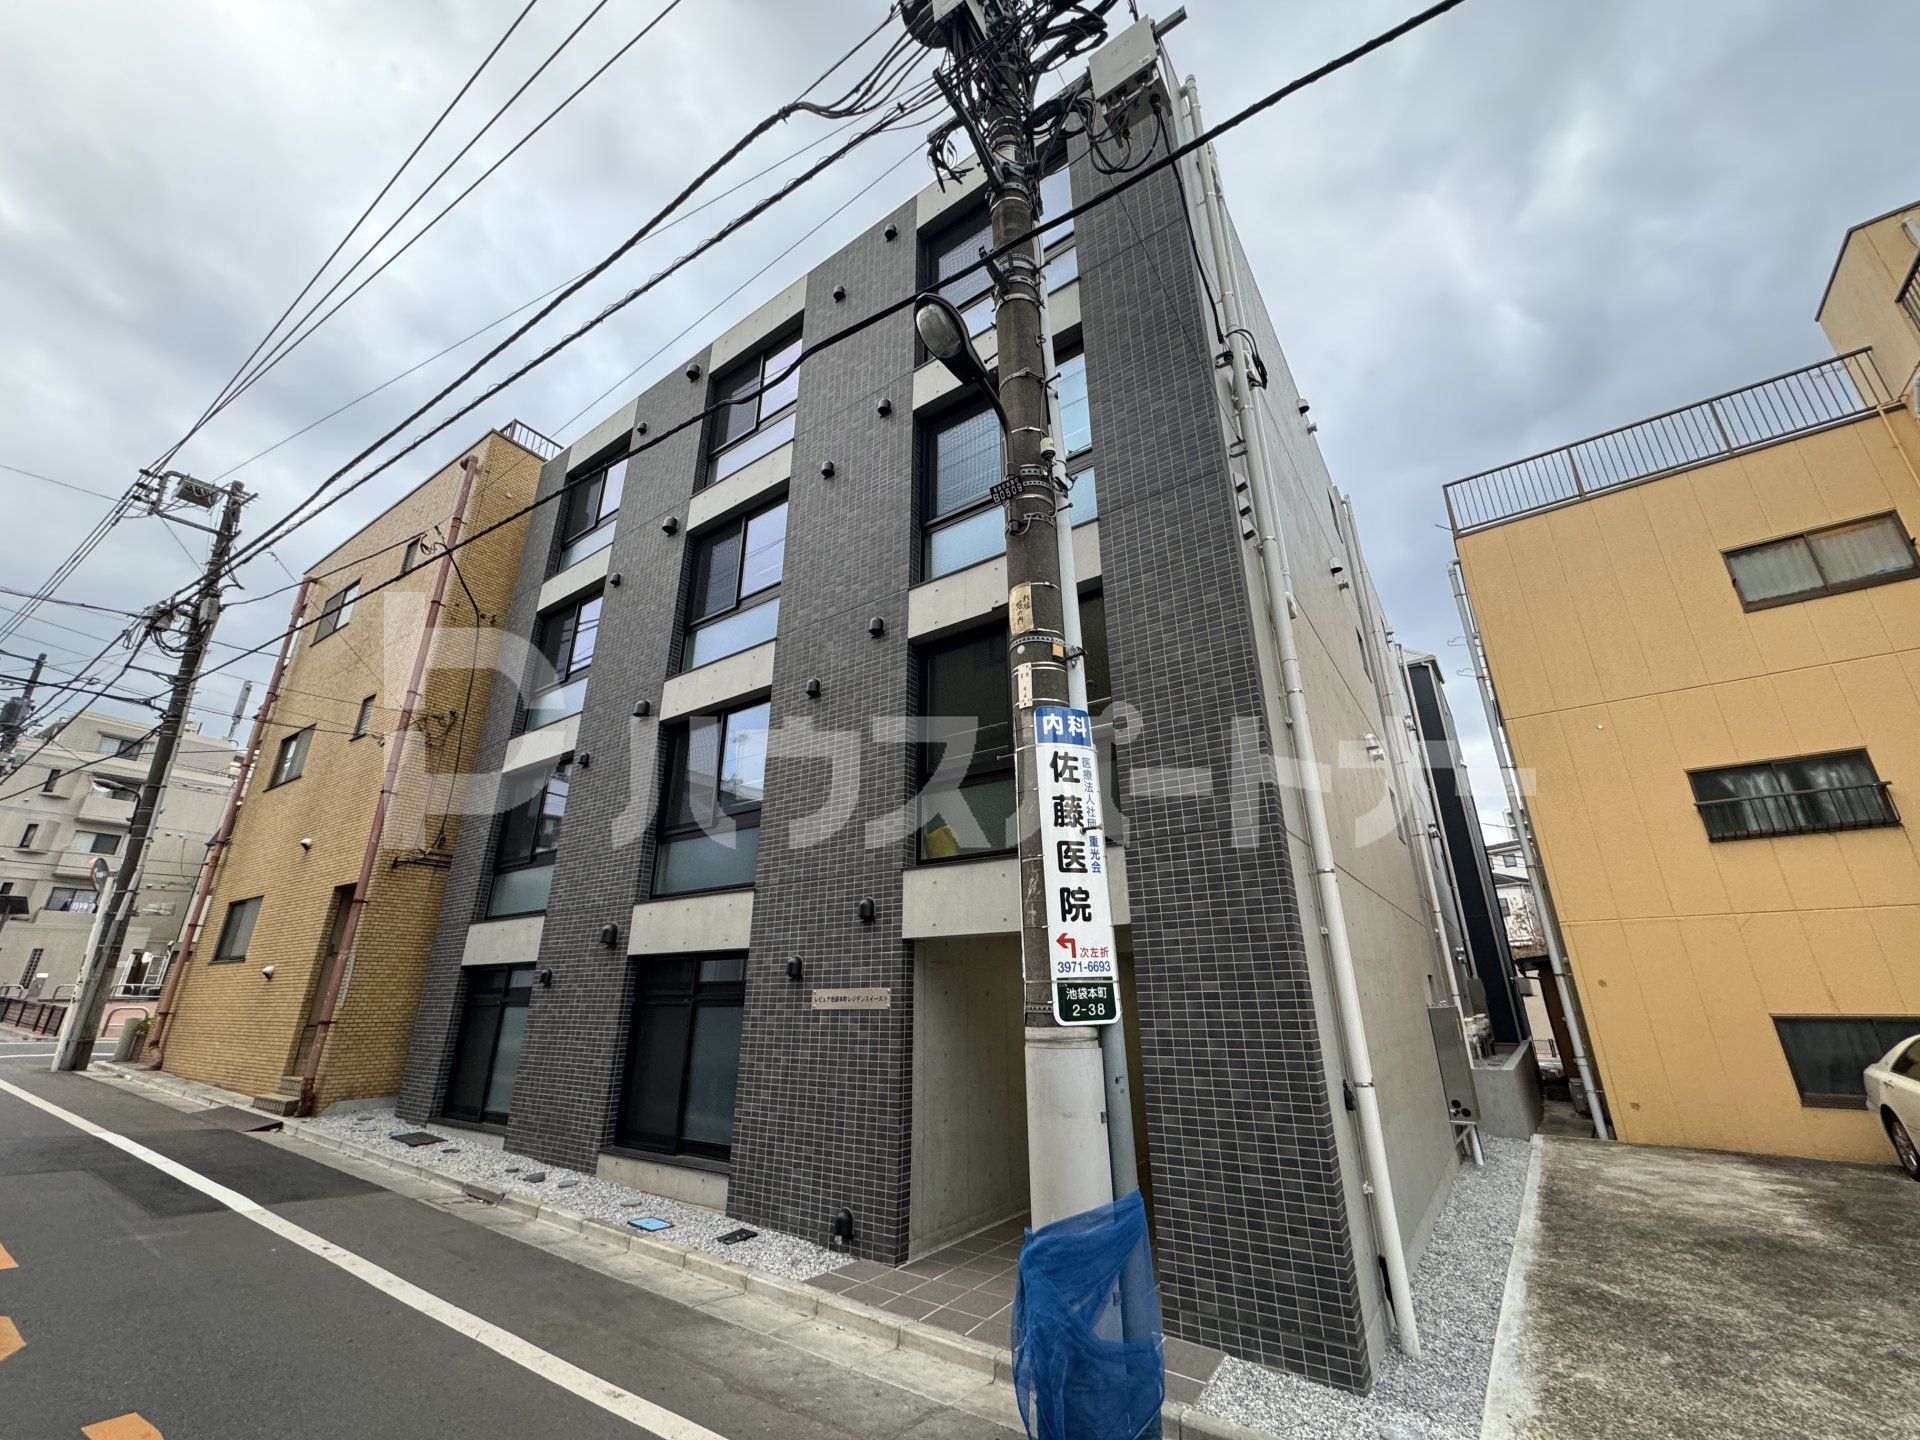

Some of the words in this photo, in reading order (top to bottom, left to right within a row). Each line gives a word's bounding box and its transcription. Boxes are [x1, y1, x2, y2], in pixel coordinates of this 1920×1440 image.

[993, 483, 1023, 503] B0509
[1042, 713, 1087, 738] 内科
[1049, 751, 1092, 923] 佐藤医院
[1079, 947, 1109, 959] 次左折
[1057, 960, 1111, 973] 3971-6693
[1066, 987, 1108, 1000] 池袋本町
[1072, 1004, 1106, 1017] 2-38
